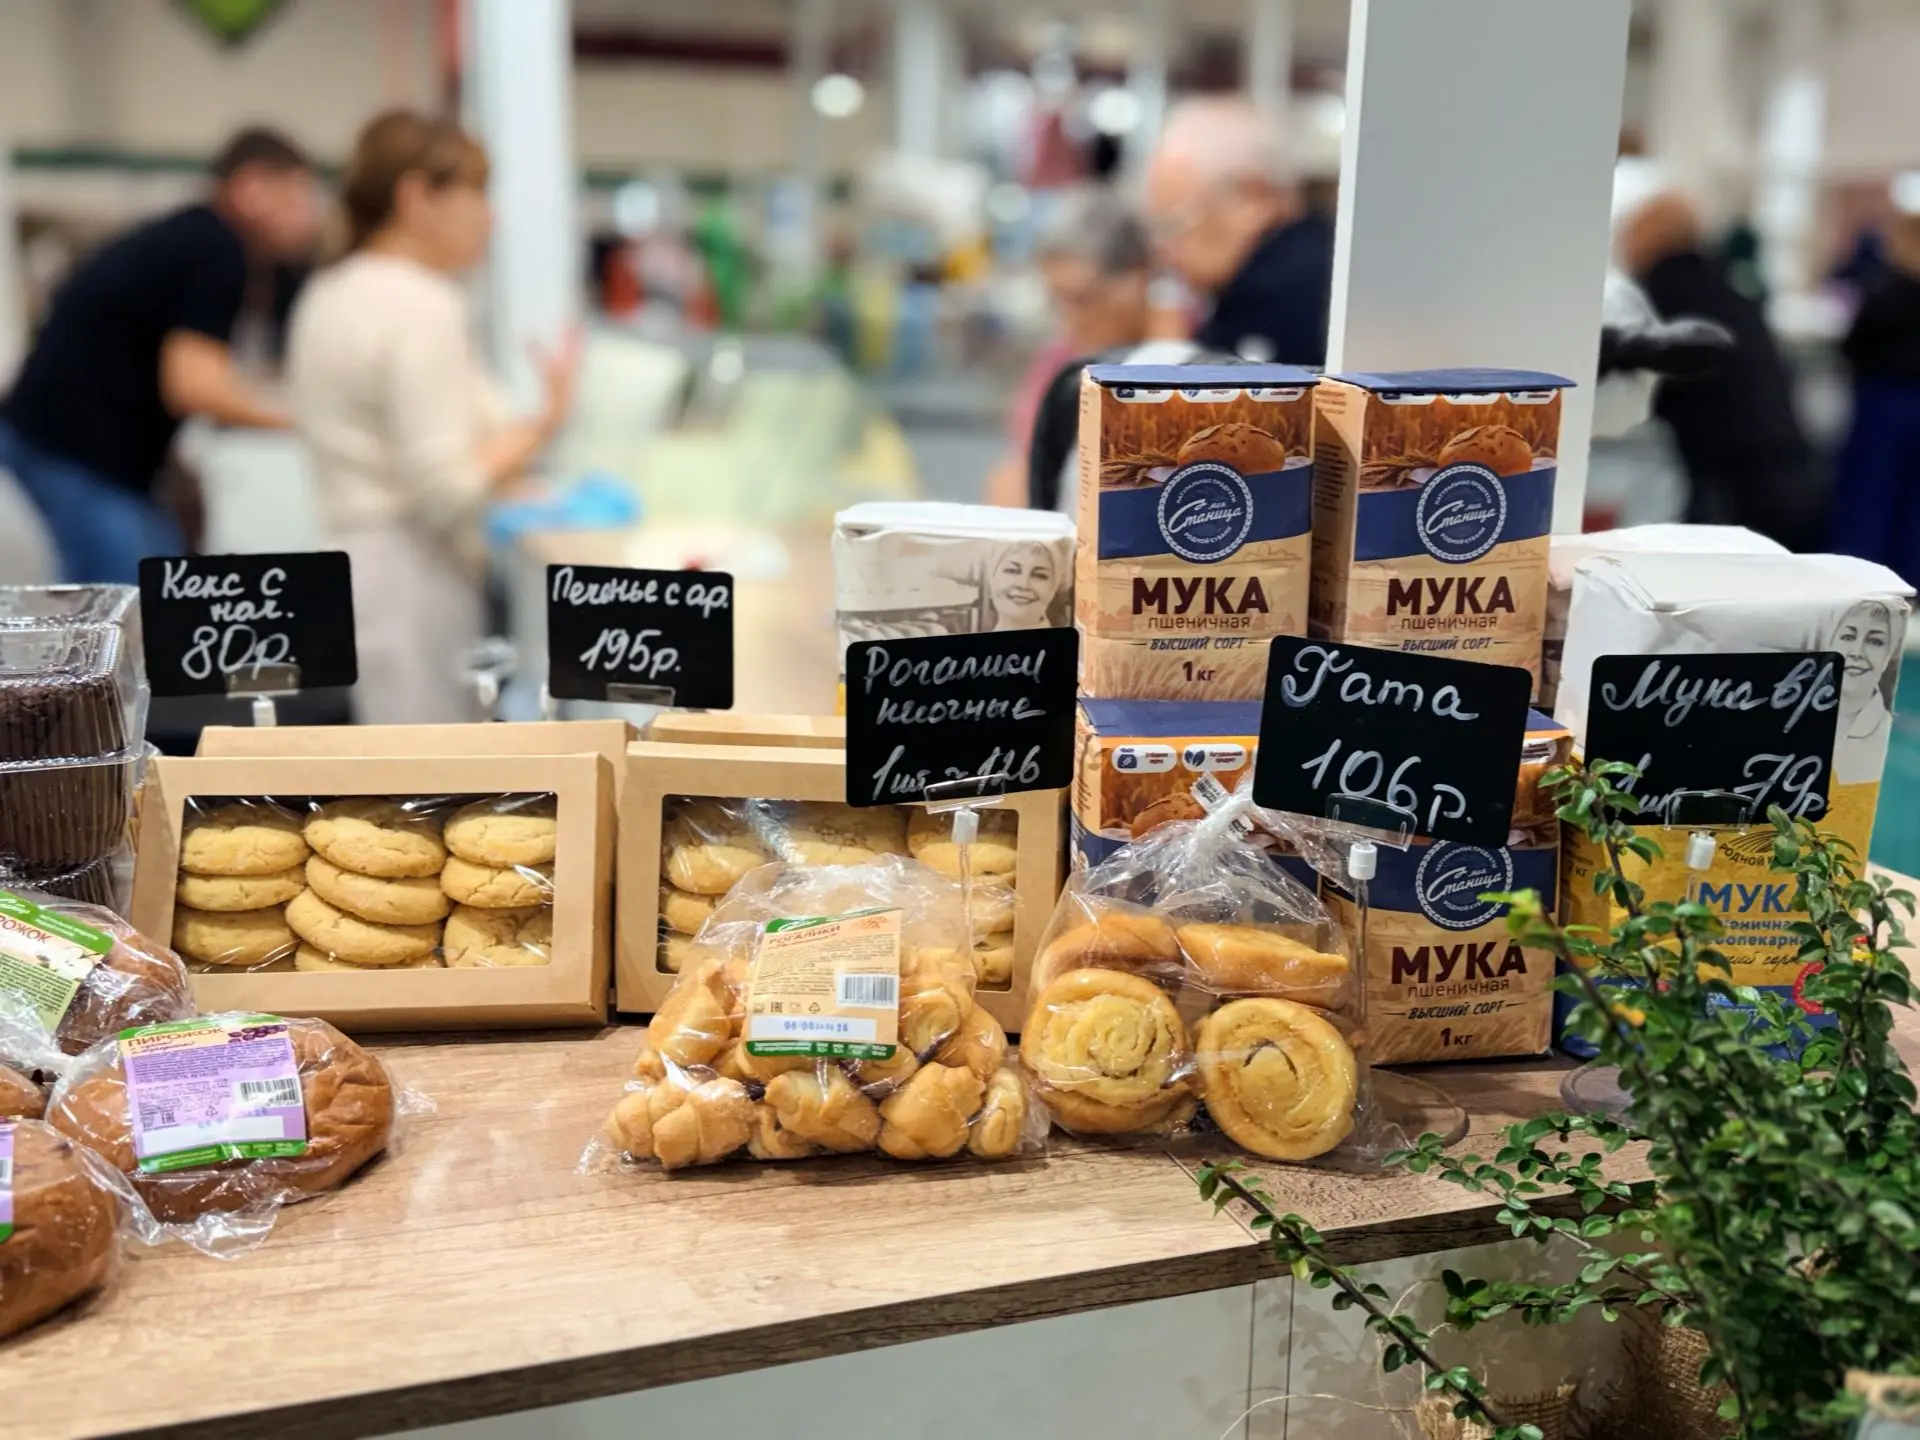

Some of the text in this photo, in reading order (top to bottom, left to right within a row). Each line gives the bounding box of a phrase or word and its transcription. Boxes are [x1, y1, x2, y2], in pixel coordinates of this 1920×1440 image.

[1168, 499, 1244, 534] Станица
[1425, 500, 1497, 535] Станица
[162, 559, 245, 600] Кекс
[552, 566, 729, 619] Печенье с ар.
[1132, 576, 1270, 616] МУКА
[1386, 575, 1516, 616] МУКА
[1148, 615, 1250, 630] пшеничная
[1400, 616, 1498, 631] пшеничная
[181, 624, 297, 680] 80р.
[579, 628, 682, 680] 195р.
[1150, 636, 1247, 650] ВЫСШИЙ СОРТ
[1401, 636, 1493, 652] ВЫСШИЙ СОРТ
[863, 645, 1047, 695] Рогалики
[1182, 660, 1216, 682] 1 кг
[1281, 645, 1480, 721] Гата
[876, 697, 1047, 726] песочные
[1601, 658, 1838, 734] Мука в/с
[1720, 843, 1765, 866] РОДНОЙ
[1426, 866, 1504, 902] Станица
[1391, 937, 1528, 985] МУКА
[1408, 978, 1510, 999] пшеничная
[1408, 1000, 1506, 1020] ВЫСШИЙ СОРТ
[128, 1027, 224, 1047] ПИРОЖОК
[1440, 1027, 1474, 1047] 1 кг
